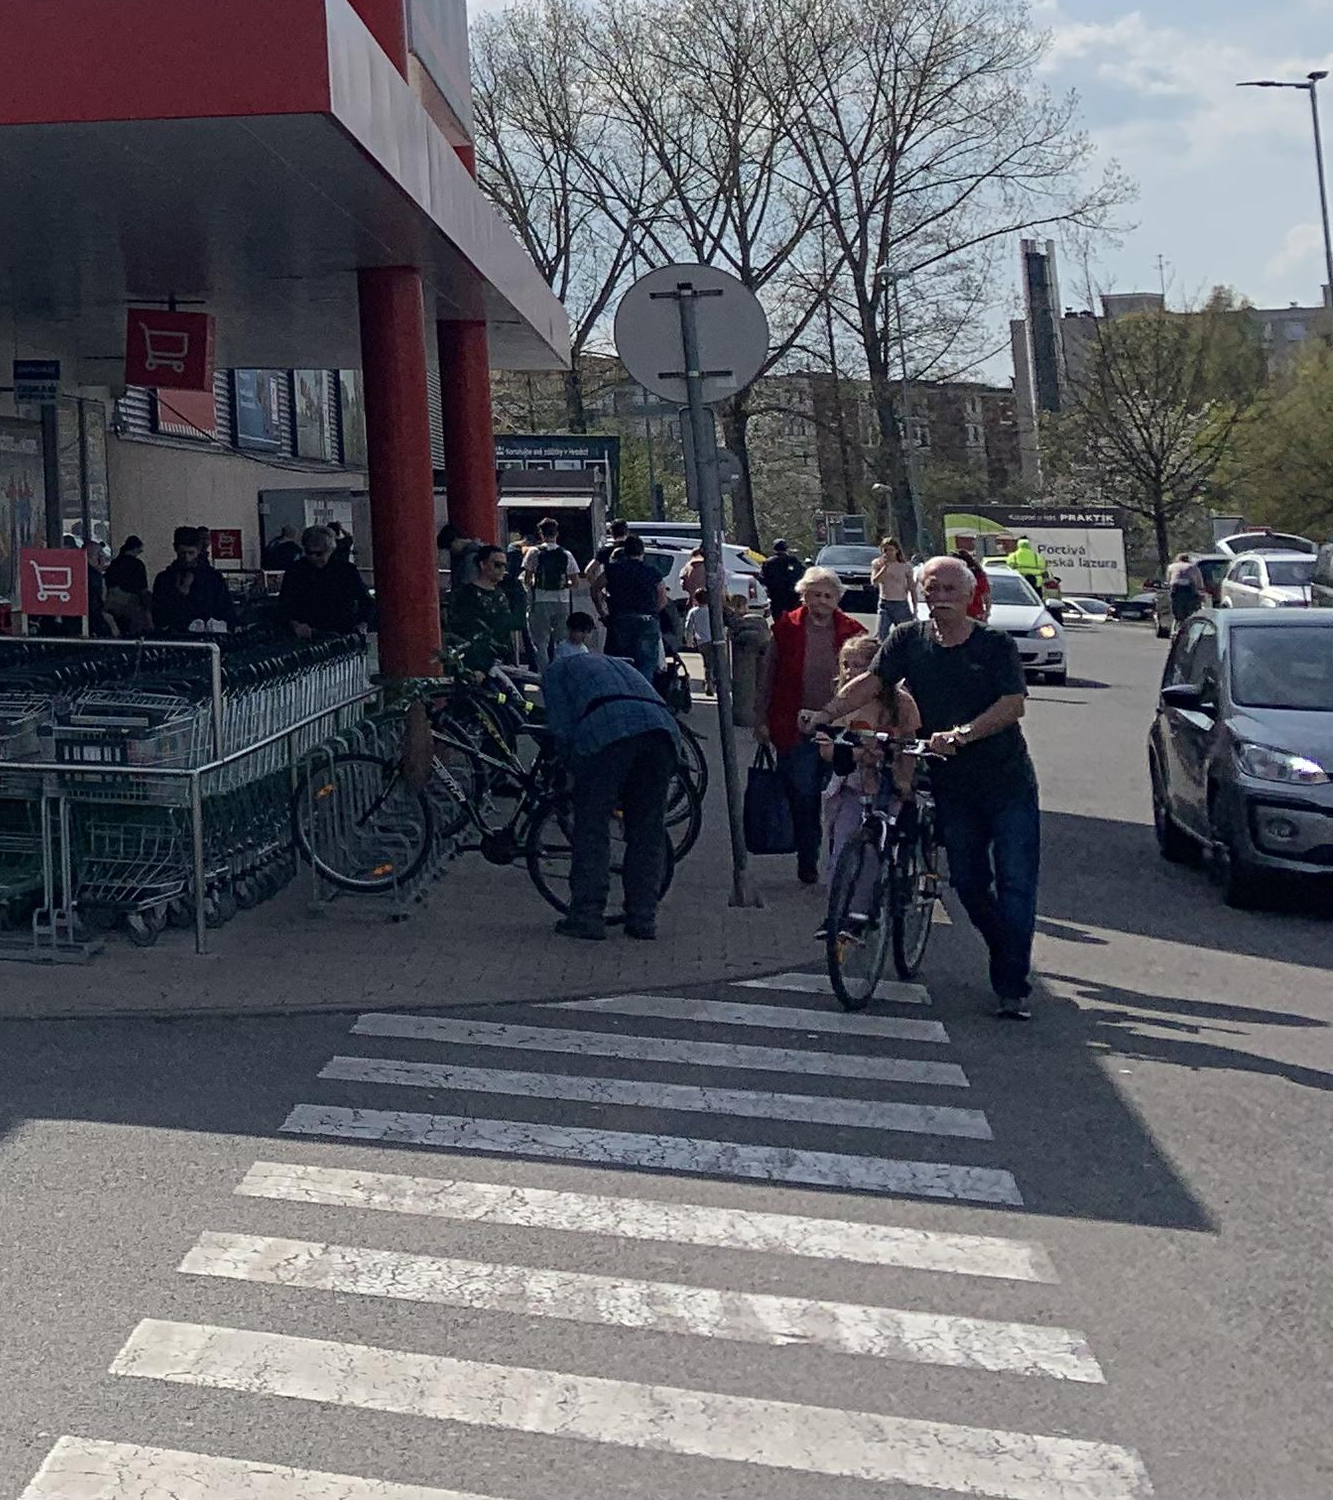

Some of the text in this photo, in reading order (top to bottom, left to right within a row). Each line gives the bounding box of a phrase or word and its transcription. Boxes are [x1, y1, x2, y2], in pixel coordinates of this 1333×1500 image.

[1060, 514, 1115, 522] PRAKTIK
[1037, 544, 1086, 556] Poctivá
[1078, 559, 1117, 569] lazura
